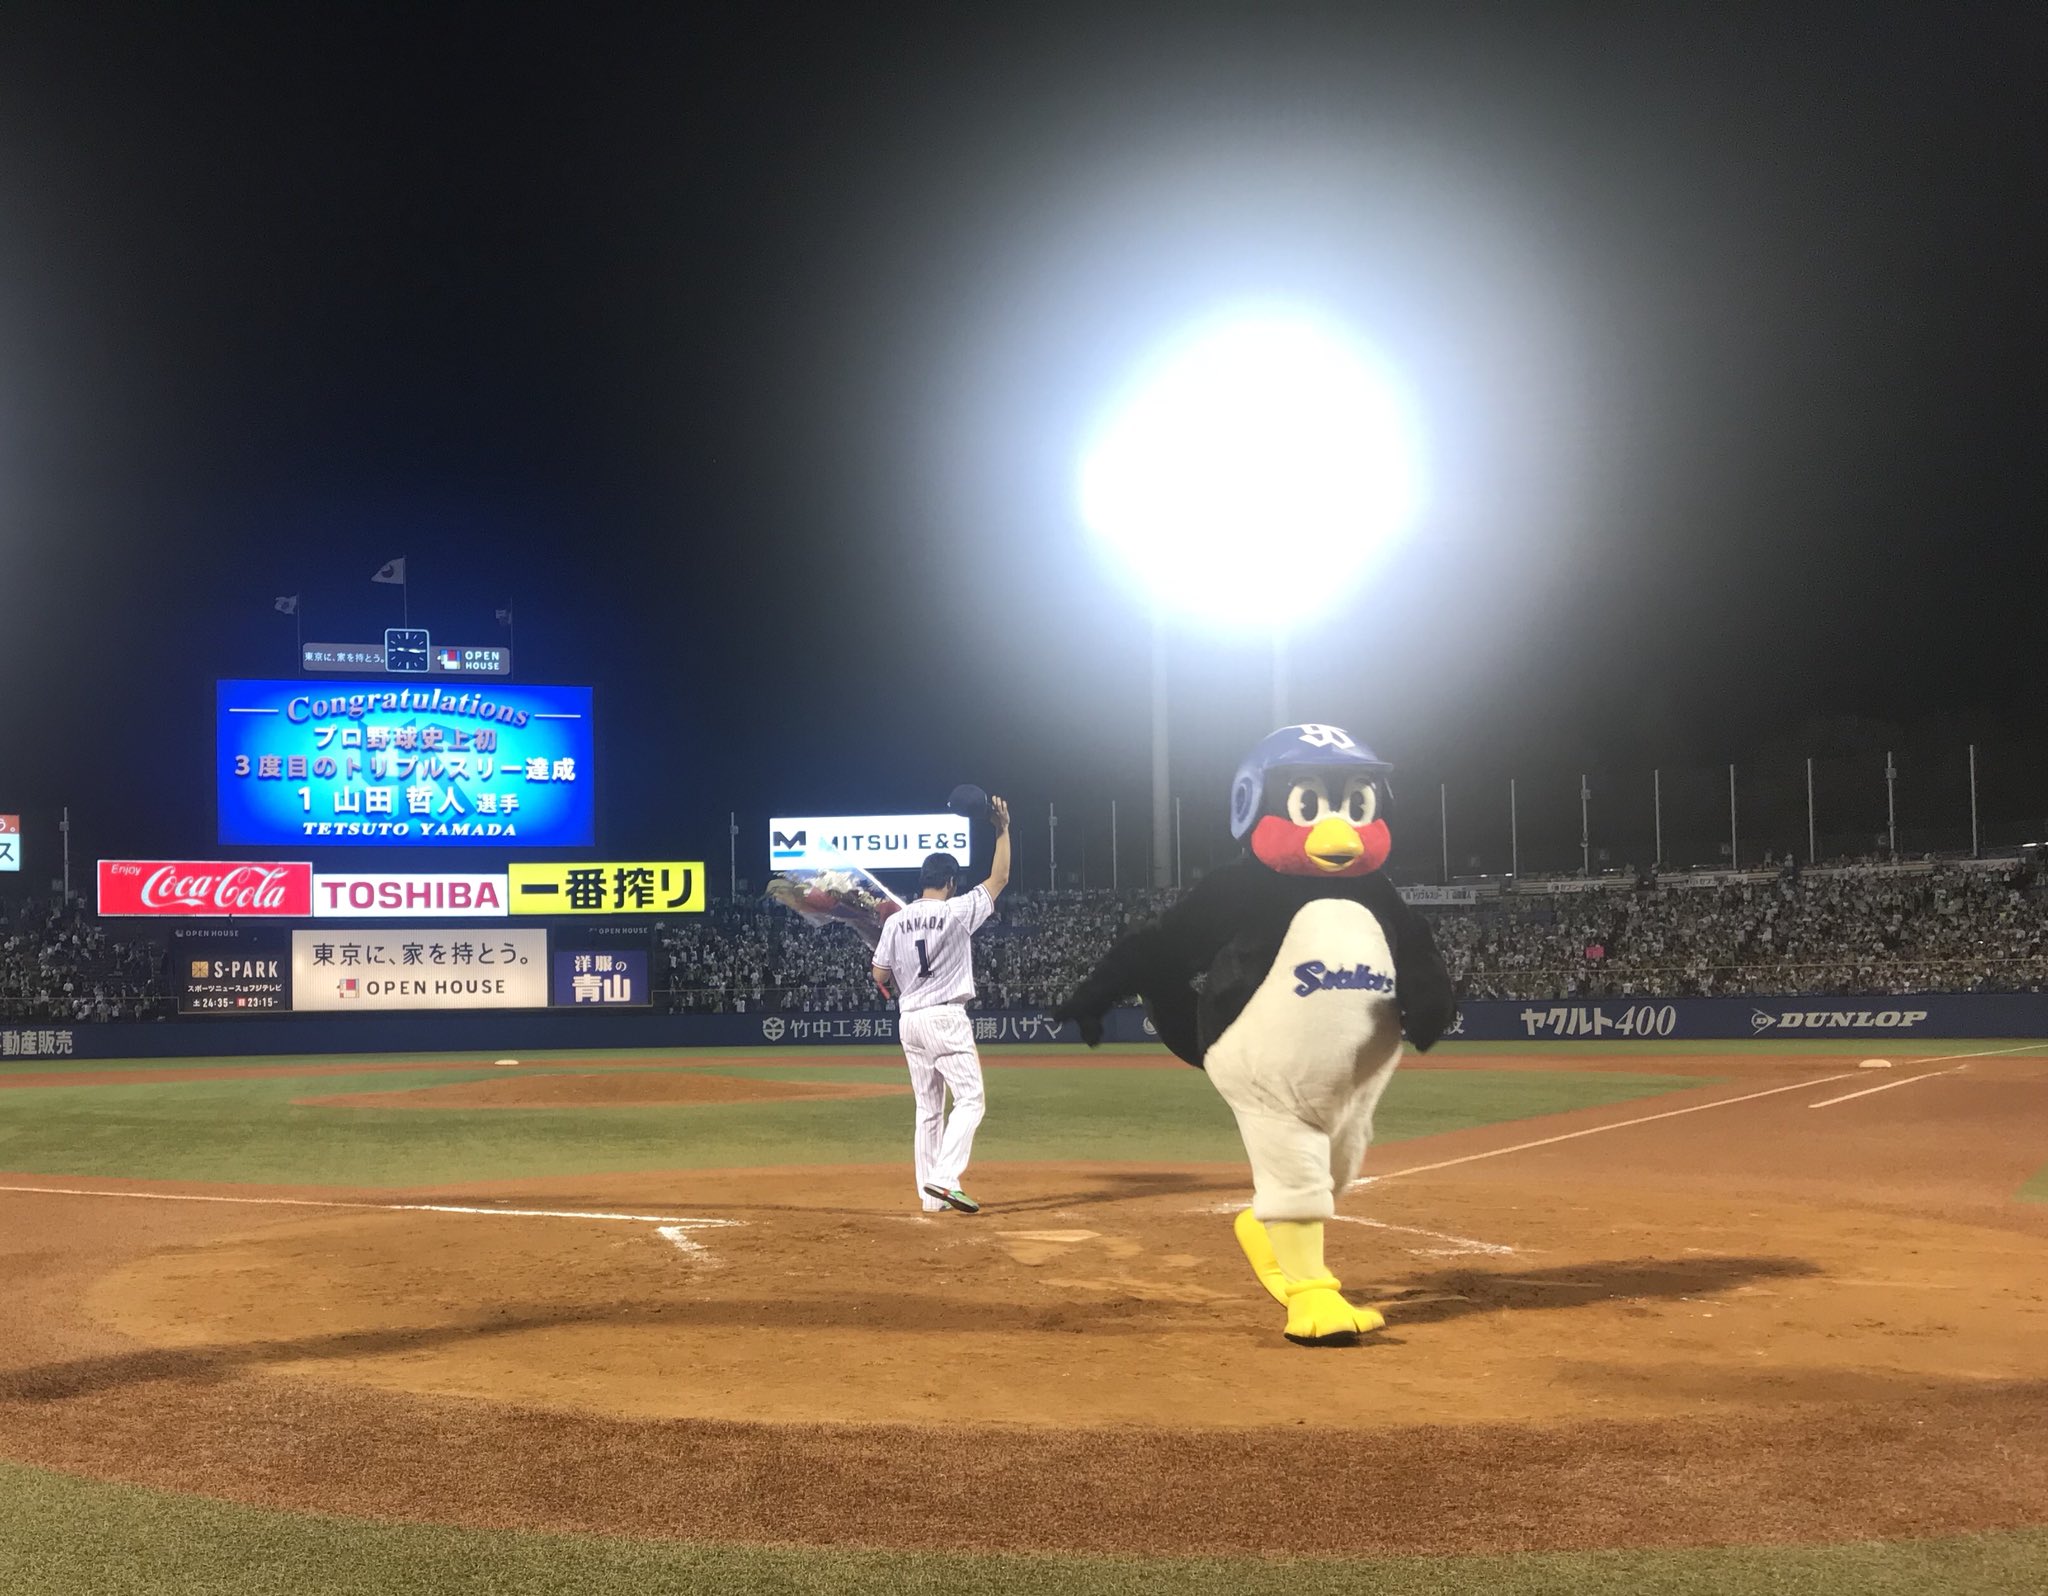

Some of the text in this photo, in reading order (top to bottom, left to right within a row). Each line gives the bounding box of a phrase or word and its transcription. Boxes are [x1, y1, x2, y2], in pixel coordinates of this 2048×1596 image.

[303, 651, 385, 664] 東京に、家を持とう。
[464, 650, 500, 661] OPEN
[464, 661, 500, 671] HOUSE
[287, 688, 530, 728] Congratulations
[313, 726, 498, 752] プロ野球史上初
[234, 753, 576, 782] 3度目のトリプルスリー達成
[298, 786, 520, 814] 1 山田 哲人 選手
[303, 822, 517, 837] TETSUTO YAMADA
[918, 833, 967, 849] E&S
[111, 864, 142, 876] Enjoy
[141, 865, 288, 908] Coca-Cola
[321, 881, 500, 909] TOSHIBA
[520, 868, 693, 910] 一番搾り
[185, 929, 239, 937] OPEN HOUSE
[898, 915, 944, 934] YAMADA
[313, 942, 529, 966] 東京に、家を持とう。
[574, 955, 627, 972] 洋服の
[914, 939, 934, 978] 1
[214, 960, 278, 978] S-PARK
[366, 979, 506, 996] OPEN HOUSE
[571, 973, 631, 1003] 青山
[790, 1017, 893, 1038] 竹中工務店
[971, 1015, 1063, 1040] 藤ハザマ
[1520, 1005, 1677, 1036] ヤクルト400
[1776, 1011, 1928, 1028] DUNLOP
[0, 1030, 73, 1055] 動産販売
